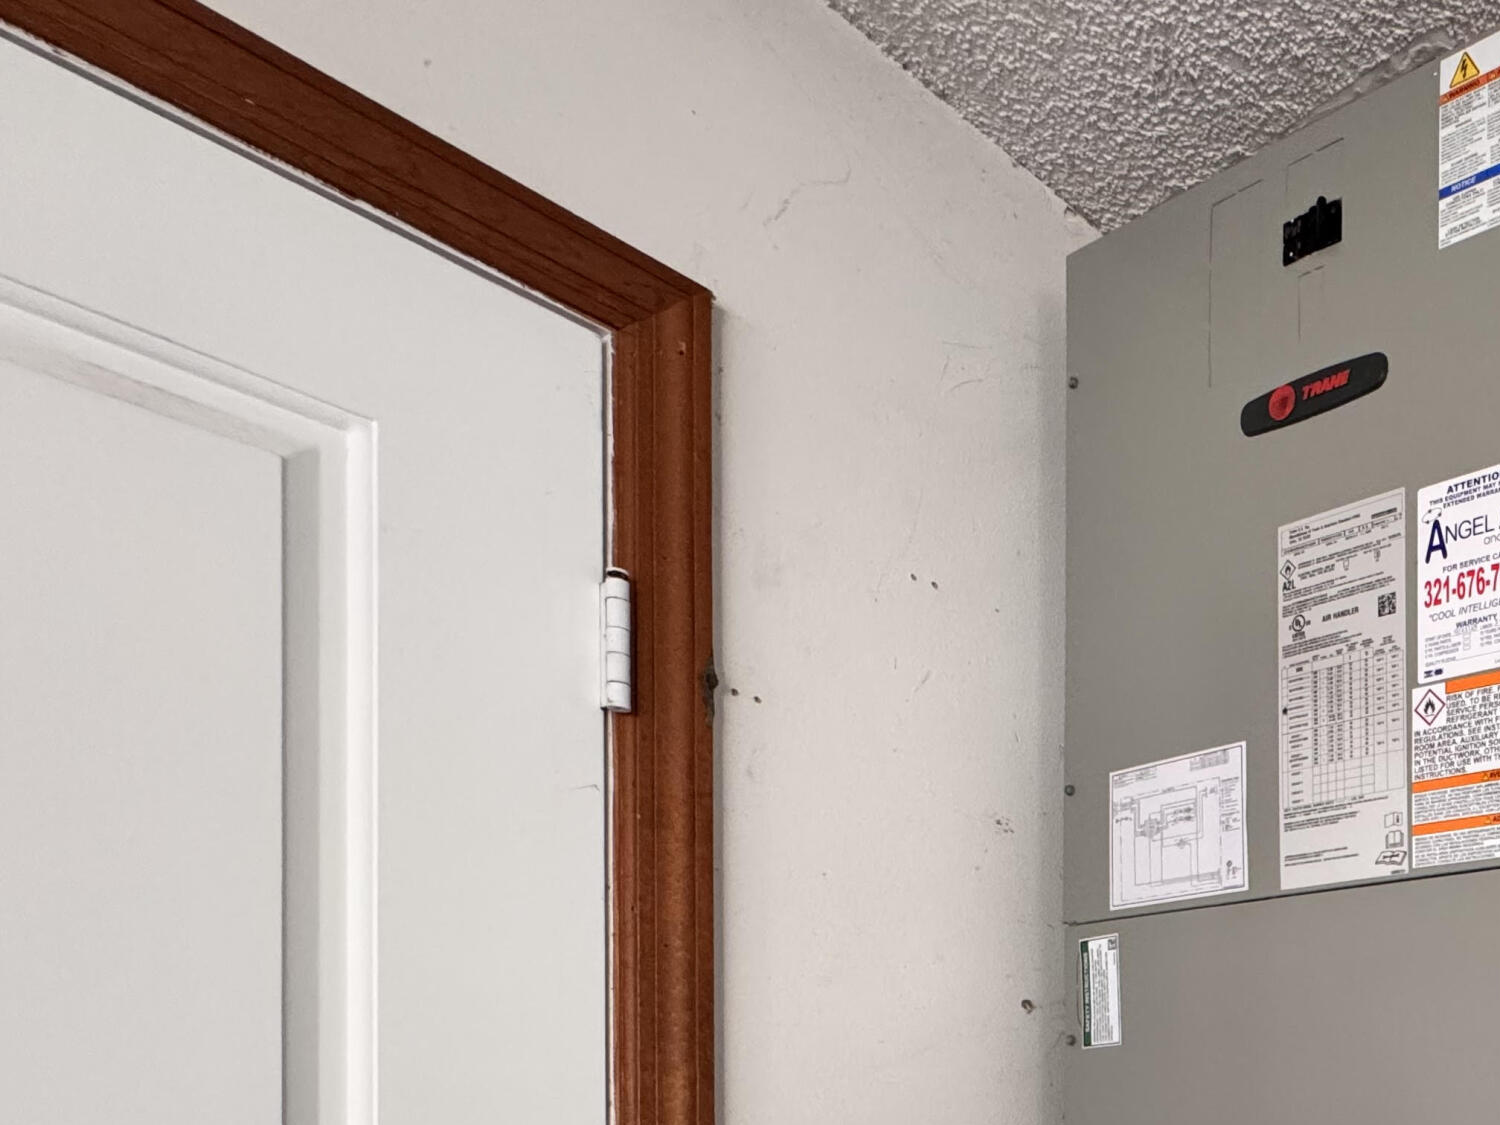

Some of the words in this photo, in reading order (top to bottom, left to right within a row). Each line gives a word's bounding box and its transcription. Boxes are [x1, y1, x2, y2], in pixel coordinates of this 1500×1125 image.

[1451, 176, 1475, 192] NOTICE
[1301, 369, 1351, 400] TRANE
[1429, 496, 1443, 506] THIS
[1445, 484, 1484, 501] EQUIPMENT
[1486, 481, 1496, 489] MAY
[1443, 494, 1474, 508] EXTENDED
[1425, 503, 1493, 564] ANGEL
[1442, 563, 1457, 573] FOR
[1459, 554, 1490, 569] SERVICE
[1321, 613, 1331, 622] AIR
[1333, 605, 1359, 619] HANDLER
[1456, 613, 1497, 629] WARRANTY
[1446, 692, 1461, 702] RISK
[1464, 690, 1474, 698] OF
[1470, 696, 1479, 704] TO
[1481, 694, 1490, 702] BE
[1446, 704, 1475, 716] SERVICE
[1446, 708, 1497, 723] REFRIGERANT
[1422, 720, 1472, 735] ACCORDANCE
[1475, 717, 1492, 726] WITH
[1467, 726, 1481, 735] SEE
[1414, 741, 1434, 750] ROOM
[1460, 730, 1498, 743] AUXILIARY
[1414, 745, 1452, 758] POTENTIAL
[1455, 740, 1486, 751] IGNITION
[1414, 762, 1437, 772] LISTED
[1440, 759, 1454, 768] FOR
[1457, 757, 1471, 765] USE
[1473, 754, 1491, 763] WITH
[1423, 755, 1435, 764] THE
